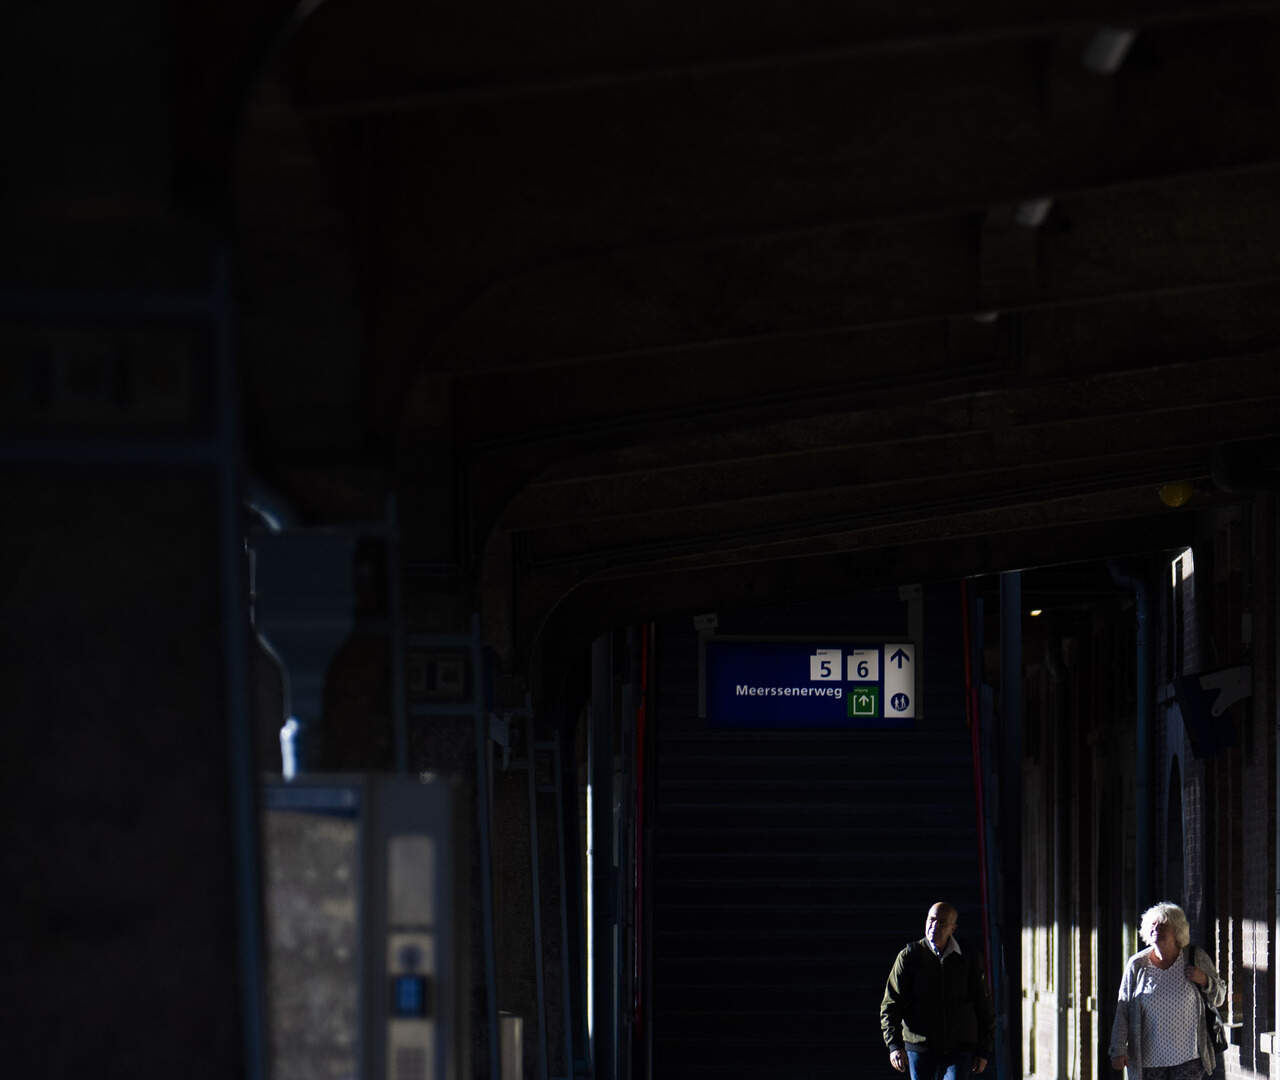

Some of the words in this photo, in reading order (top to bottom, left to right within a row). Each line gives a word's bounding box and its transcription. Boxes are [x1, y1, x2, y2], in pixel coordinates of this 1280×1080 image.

[820, 660, 832, 678] 5
[857, 660, 869, 678] 6
[736, 684, 843, 699] Meerssenerweg
